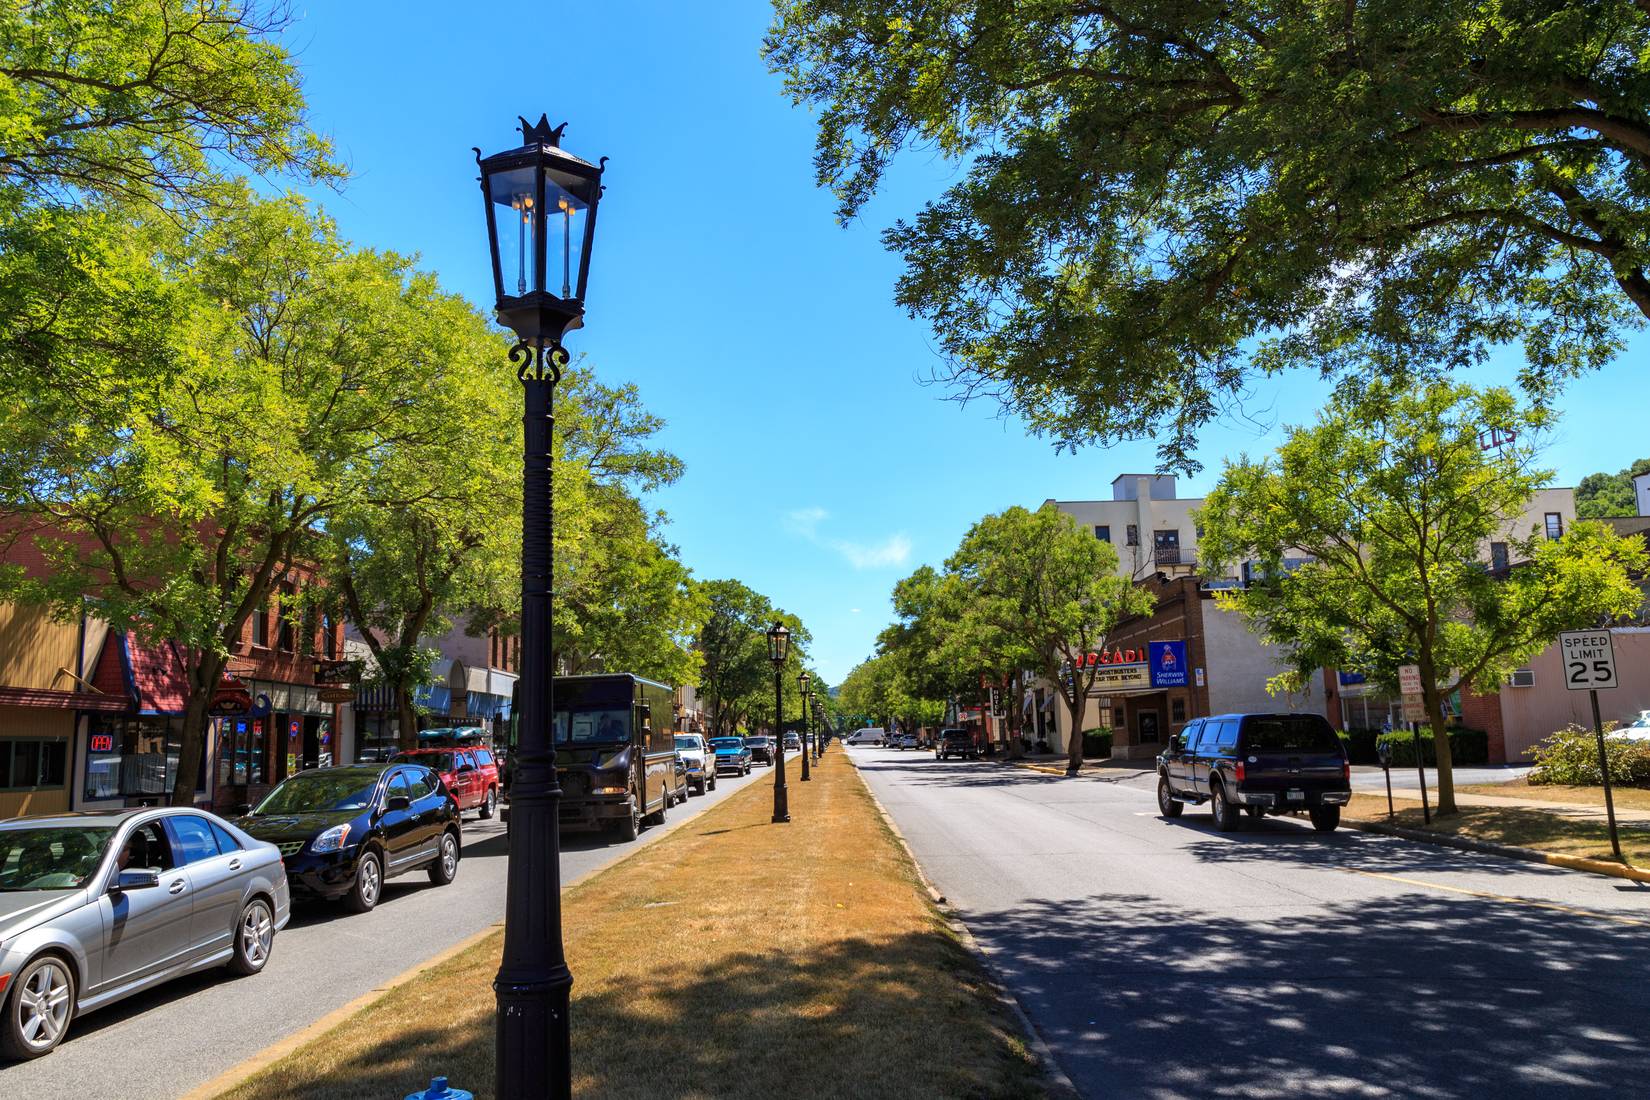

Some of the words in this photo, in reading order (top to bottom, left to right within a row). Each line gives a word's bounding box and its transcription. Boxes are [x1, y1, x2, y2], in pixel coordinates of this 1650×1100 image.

[1564, 636, 1608, 648] SPEED
[1570, 648, 1604, 659] LIMIT
[1568, 660, 1612, 683] 25
[91, 735, 113, 751] OPEN
